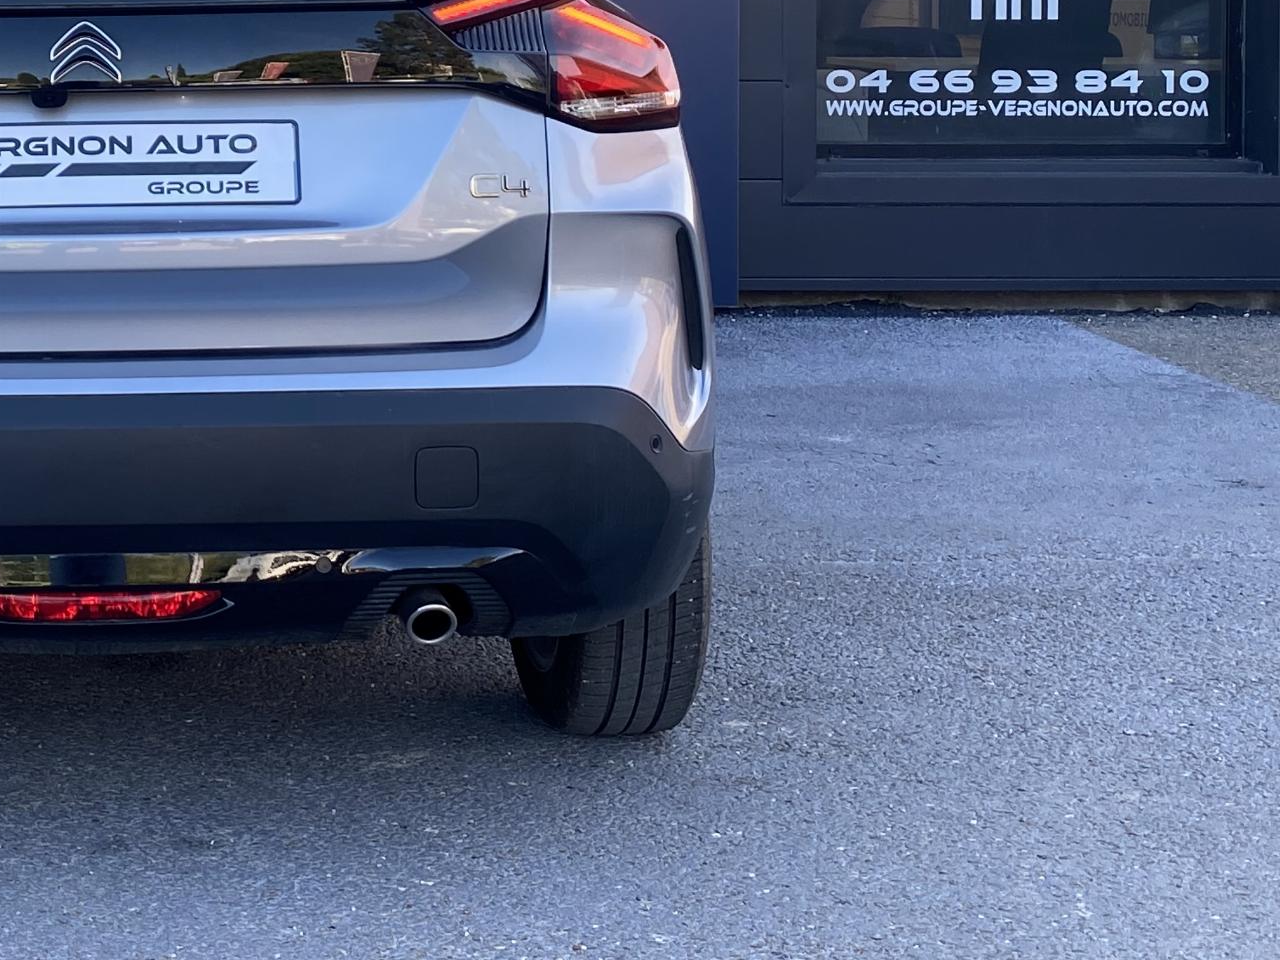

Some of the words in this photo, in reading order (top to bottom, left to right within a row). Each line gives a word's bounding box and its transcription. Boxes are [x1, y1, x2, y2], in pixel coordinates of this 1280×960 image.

[825, 70, 892, 94] 04
[909, 70, 974, 94] 66
[991, 70, 1058, 94] 93
[1075, 70, 1143, 94] 84
[1165, 70, 1210, 94] 10
[826, 100, 1209, 117] WWW.GROUPE-VERGNONAUTO.COM
[146, 134, 258, 155] AUTO
[148, 180, 260, 195] GROUPE
[469, 173, 533, 198] C4
